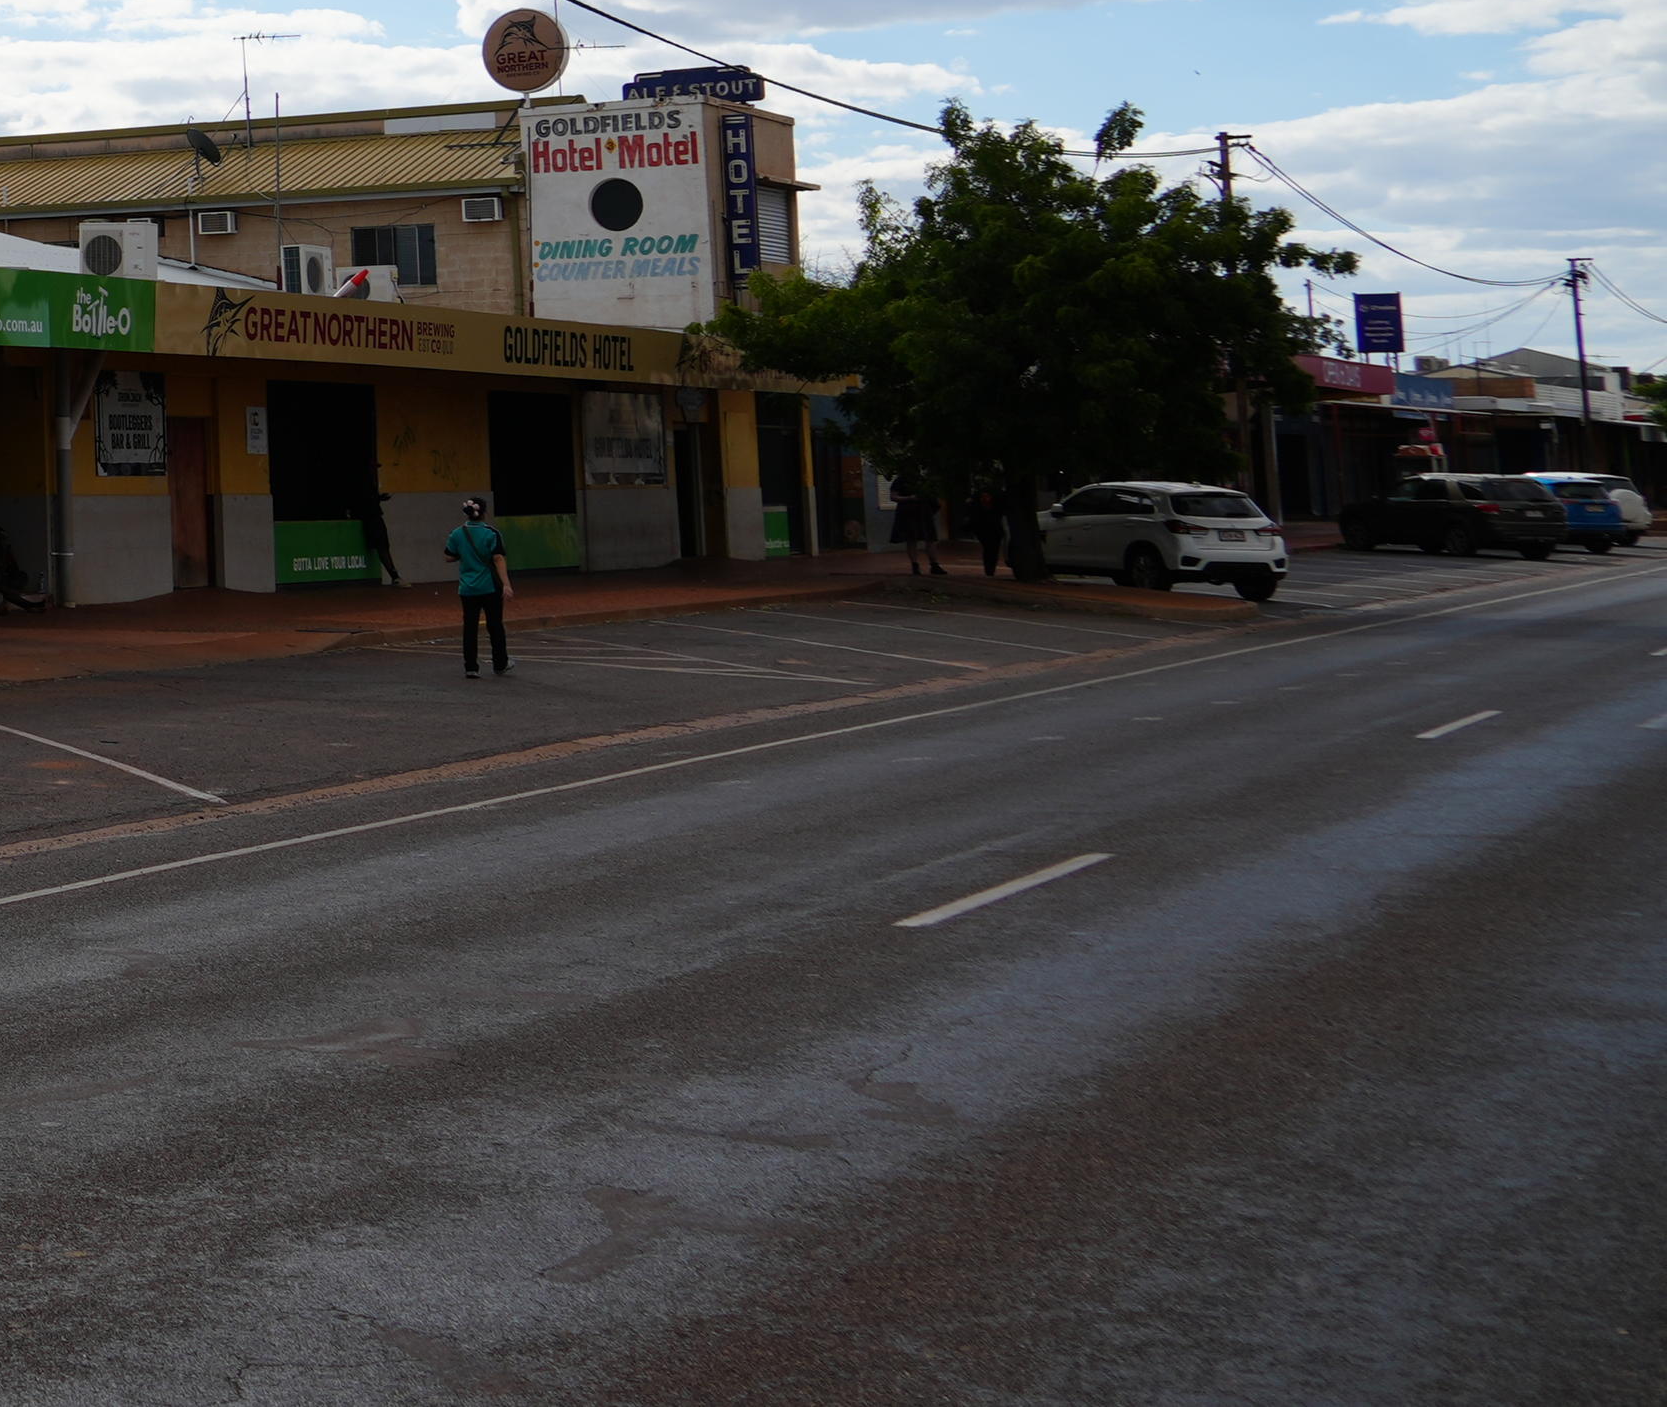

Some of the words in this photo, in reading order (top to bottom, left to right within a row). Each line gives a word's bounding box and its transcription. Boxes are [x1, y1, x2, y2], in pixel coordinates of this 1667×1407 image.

[496, 49, 547, 65] GREAT
[497, 61, 549, 74] NORTHERN
[689, 78, 758, 97] STOUT
[535, 110, 682, 138] GOLDFIELDS
[532, 137, 603, 174] Hotel
[618, 131, 699, 170] Motel
[726, 129, 753, 275] HOTEL
[538, 239, 613, 260] DINING
[620, 233, 699, 257] ROOM
[536, 260, 627, 282] COUNTER
[628, 256, 701, 279] MEALS
[76, 289, 92, 304] the
[417, 321, 455, 339] BREWING
[503, 326, 588, 368] GOLDFIELDS
[593, 335, 635, 371] HOTEL
[108, 414, 153, 431] BOOTLEGGERS
[111, 433, 124, 449] BAR
[126, 434, 132, 449] &
[133, 433, 152, 450] GRILL
[293, 557, 313, 571] GOTTA
[314, 557, 329, 570] LOVE
[330, 556, 346, 570] YOUR
[347, 555, 367, 569] LOCAL
